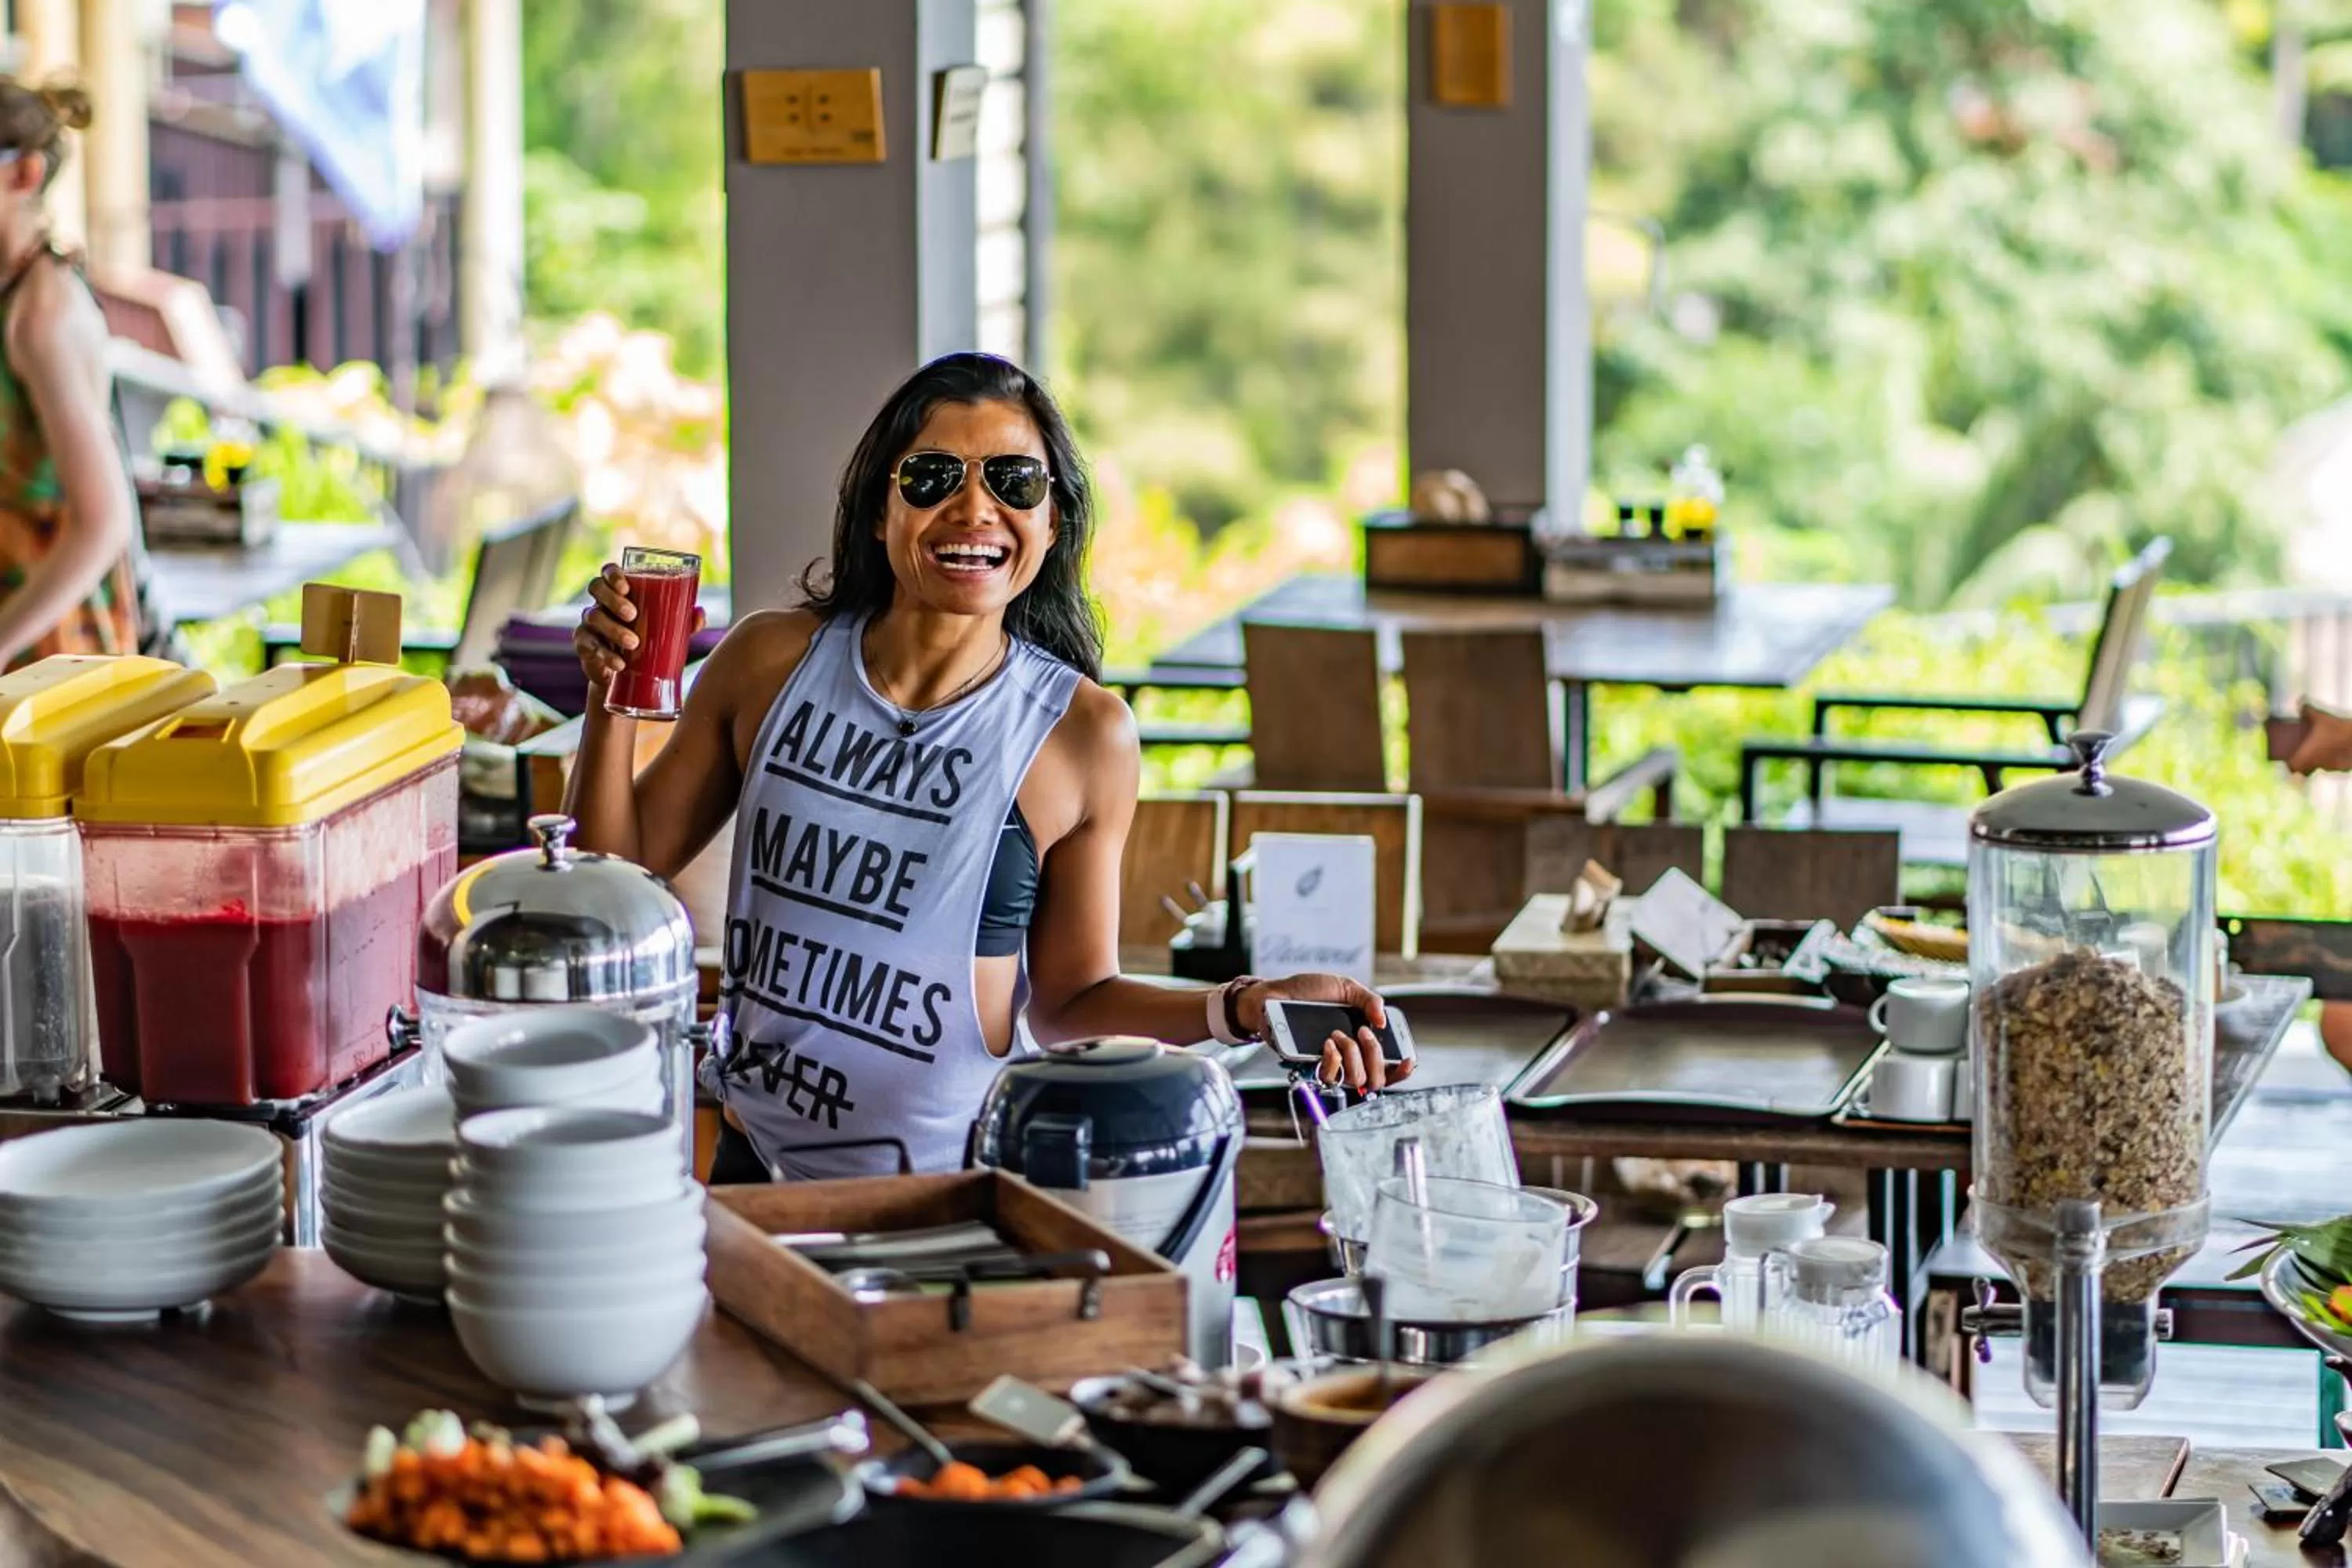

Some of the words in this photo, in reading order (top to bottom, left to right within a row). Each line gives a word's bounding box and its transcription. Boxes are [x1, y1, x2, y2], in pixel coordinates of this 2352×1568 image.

[771, 701, 972, 808] ALWAYS
[751, 806, 928, 917] MAYBE
[724, 915, 951, 1047] OMETIMES
[729, 1031, 848, 1130] EVER
